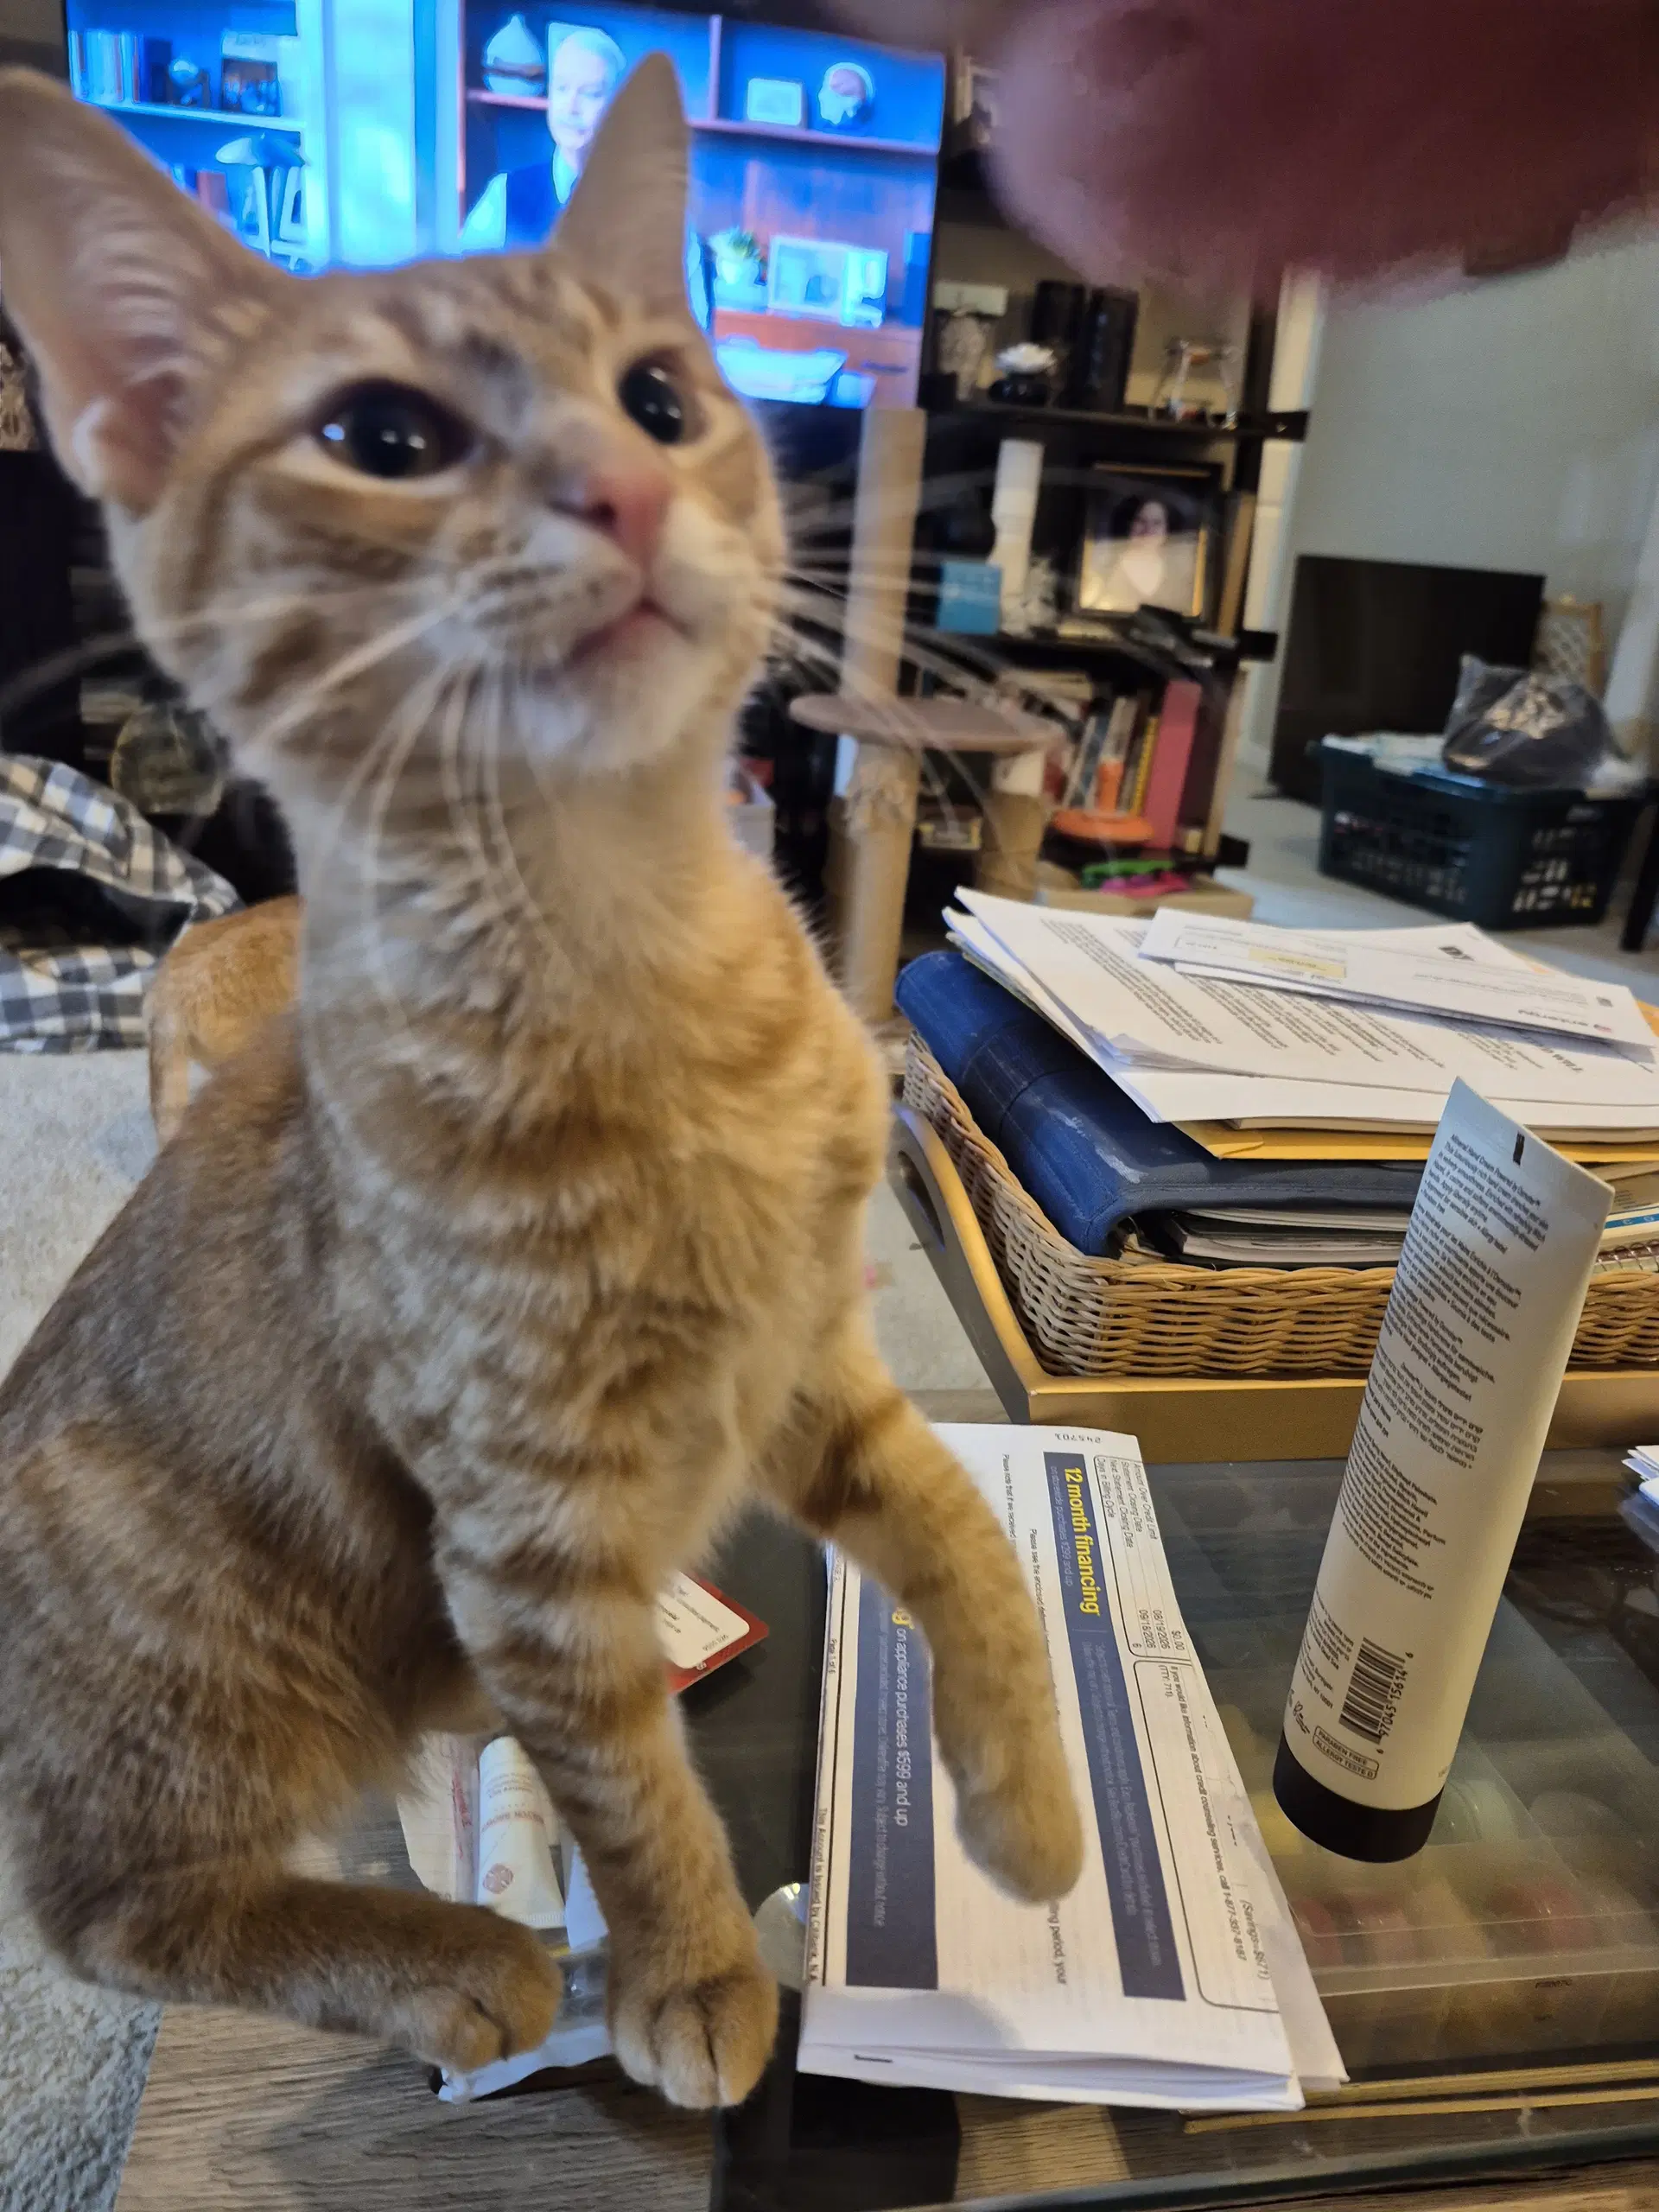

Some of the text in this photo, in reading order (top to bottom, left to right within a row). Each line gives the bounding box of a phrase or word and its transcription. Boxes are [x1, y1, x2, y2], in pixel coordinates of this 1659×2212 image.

[1478, 1155, 1495, 1173] Cream
[1001, 1453, 1011, 1471] Please
[1096, 1457, 1106, 1472] Days
[1109, 1459, 1119, 1472] Next
[1065, 1466, 1081, 1483] 12
[1120, 1461, 1134, 1491] Statement
[1101, 1481, 1111, 1498] Billing
[1111, 1474, 1126, 1505] Statement
[1067, 1484, 1089, 1533] month
[1104, 1500, 1116, 1517] Cycle
[1127, 1492, 1140, 1516] Closing
[1048, 1465, 1075, 1586] on storewide purchases $299 and up
[1118, 1506, 1131, 1531] Closing
[1133, 1516, 1143, 1532] Date
[1027, 1528, 1038, 1549] Please
[1124, 1532, 1135, 1548] Date
[1030, 1550, 1039, 1563] see
[1133, 1463, 1185, 1650] Amount Over Credit Limit $0.00
[1031, 1564, 1041, 1574] the
[894, 1627, 910, 1643] on
[894, 1642, 910, 1690] appliance
[1171, 1670, 1181, 1682] you
[1173, 1683, 1185, 1701] would
[1178, 1702, 1189, 1713] like
[894, 1691, 911, 1747] purchases
[1180, 1714, 1198, 1751] information
[1318, 1729, 1347, 1756] PARABEN
[1314, 1738, 1344, 1764] ALLERGY
[893, 1749, 911, 1778] $599
[1189, 1752, 1203, 1773] about
[893, 1781, 911, 1805] and
[1194, 1774, 1208, 1795] credit
[893, 1808, 911, 1827] up
[1198, 1796, 1217, 1836] counseling
[814, 1827, 826, 1862] Account
[1217, 1874, 1230, 1890] call
[810, 1906, 822, 1916] by
[1048, 1925, 1065, 1959] period,
[1052, 1961, 1068, 1985] your
